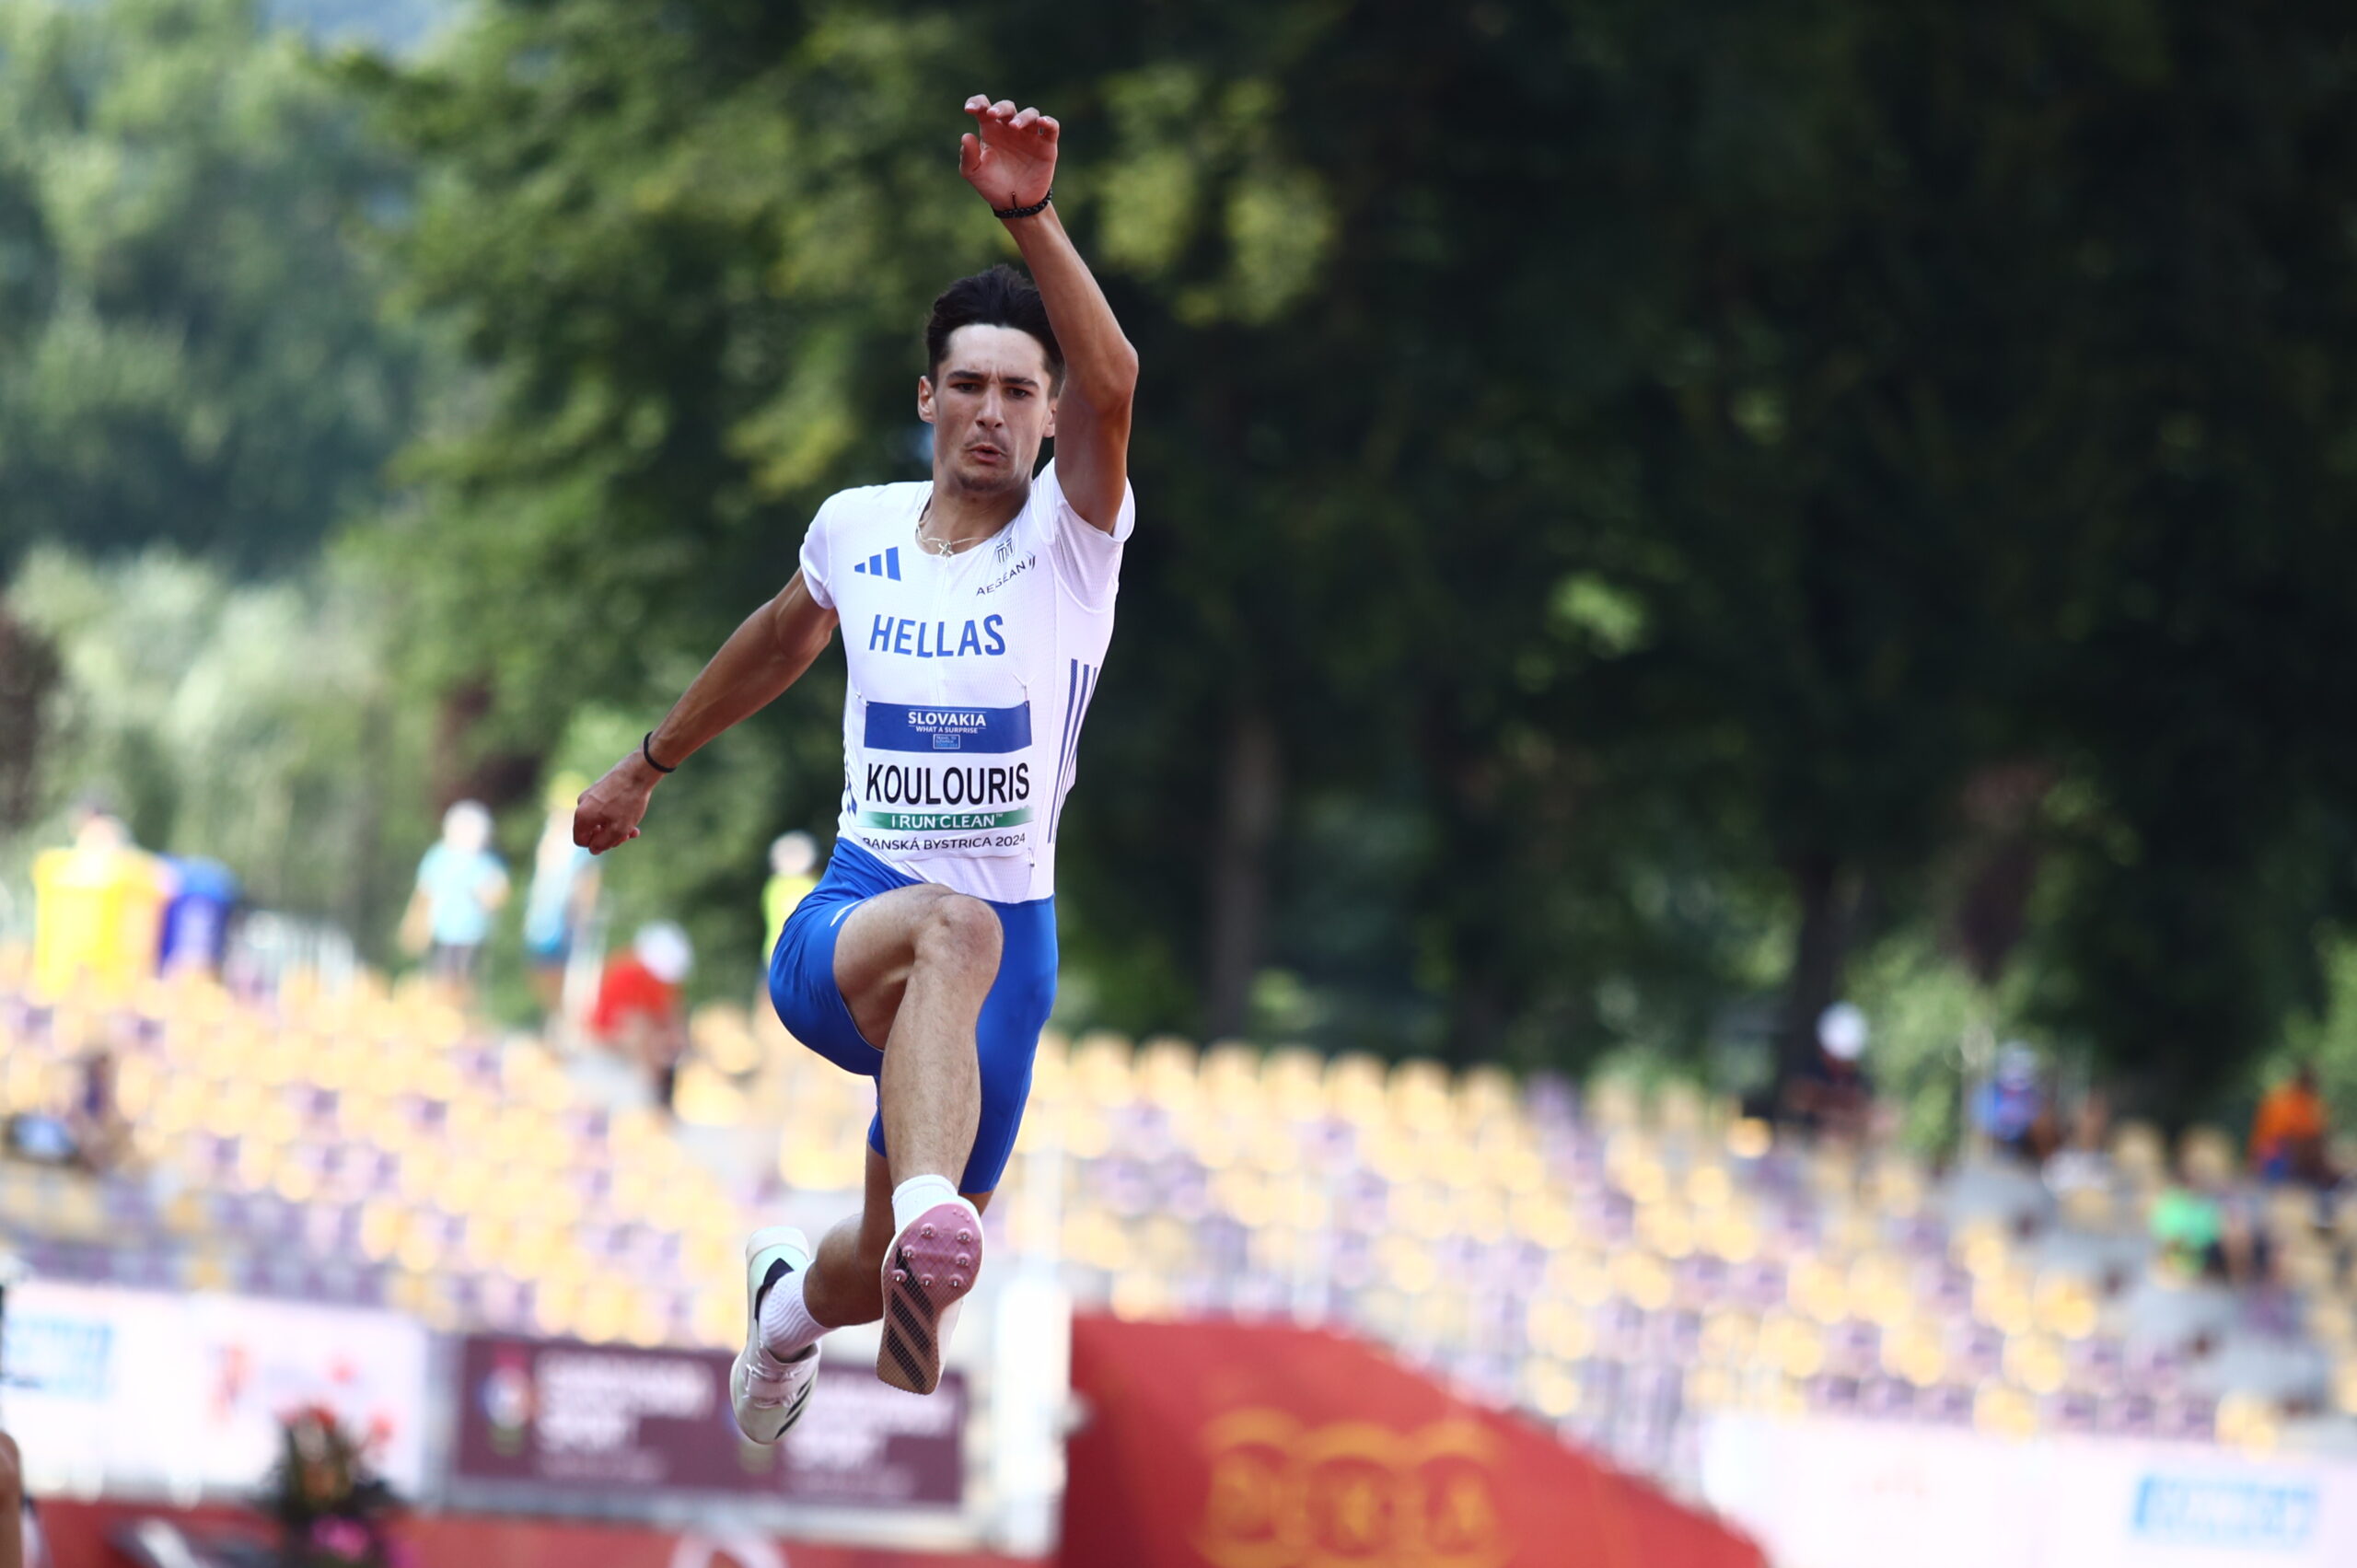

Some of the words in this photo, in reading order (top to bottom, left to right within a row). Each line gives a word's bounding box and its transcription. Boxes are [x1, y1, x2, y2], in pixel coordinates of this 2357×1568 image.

[976, 560, 1027, 597] AEGEAN
[869, 614, 1005, 657] HELLAS
[909, 712, 986, 726] SLOVAKIA
[865, 762, 1030, 806] KOULOURIS
[891, 815, 896, 828] I
[899, 815, 936, 829] RUN
[923, 837, 992, 851] BYSTRICA
[995, 832, 1026, 847] 2024
